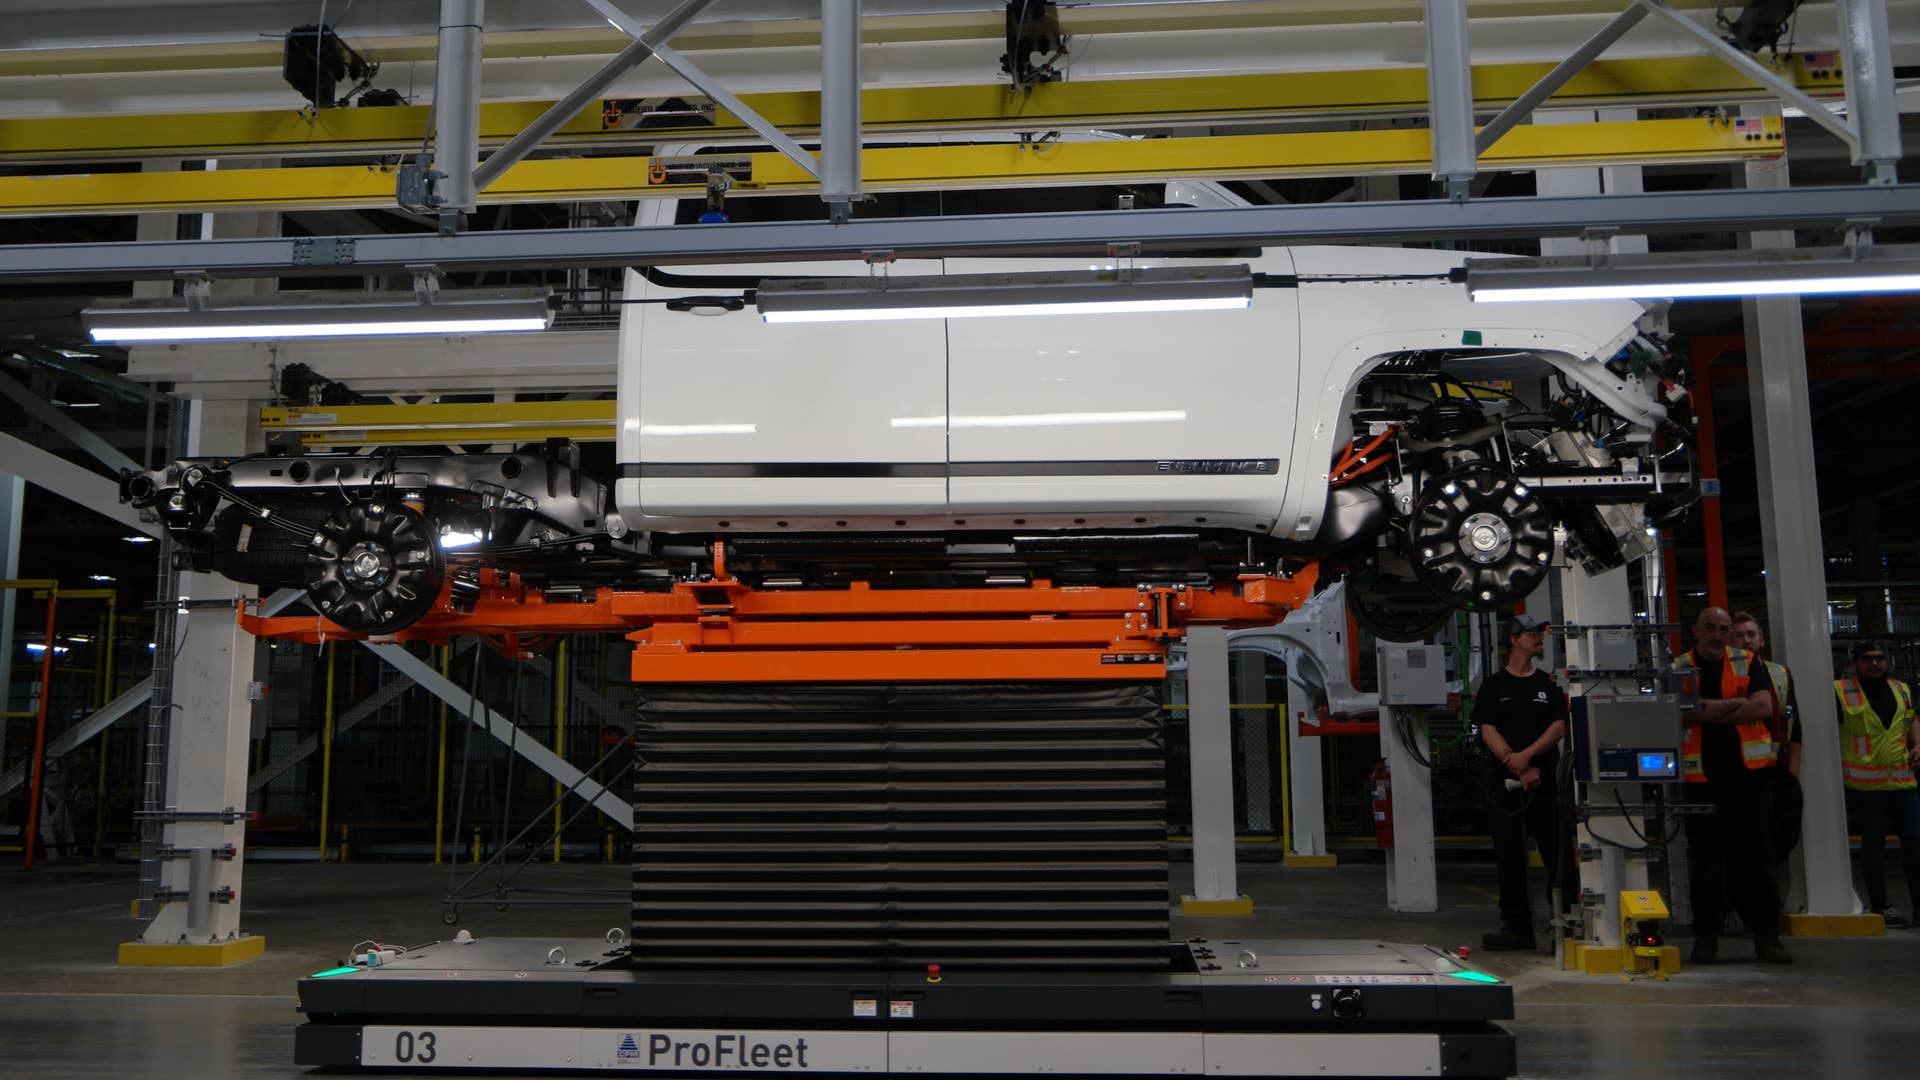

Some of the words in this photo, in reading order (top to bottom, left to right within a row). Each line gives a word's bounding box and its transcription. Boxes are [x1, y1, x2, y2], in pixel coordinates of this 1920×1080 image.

[396, 1031, 436, 1063] 03
[617, 1050, 640, 1058] CPM
[649, 1034, 808, 1068] ProFleet
